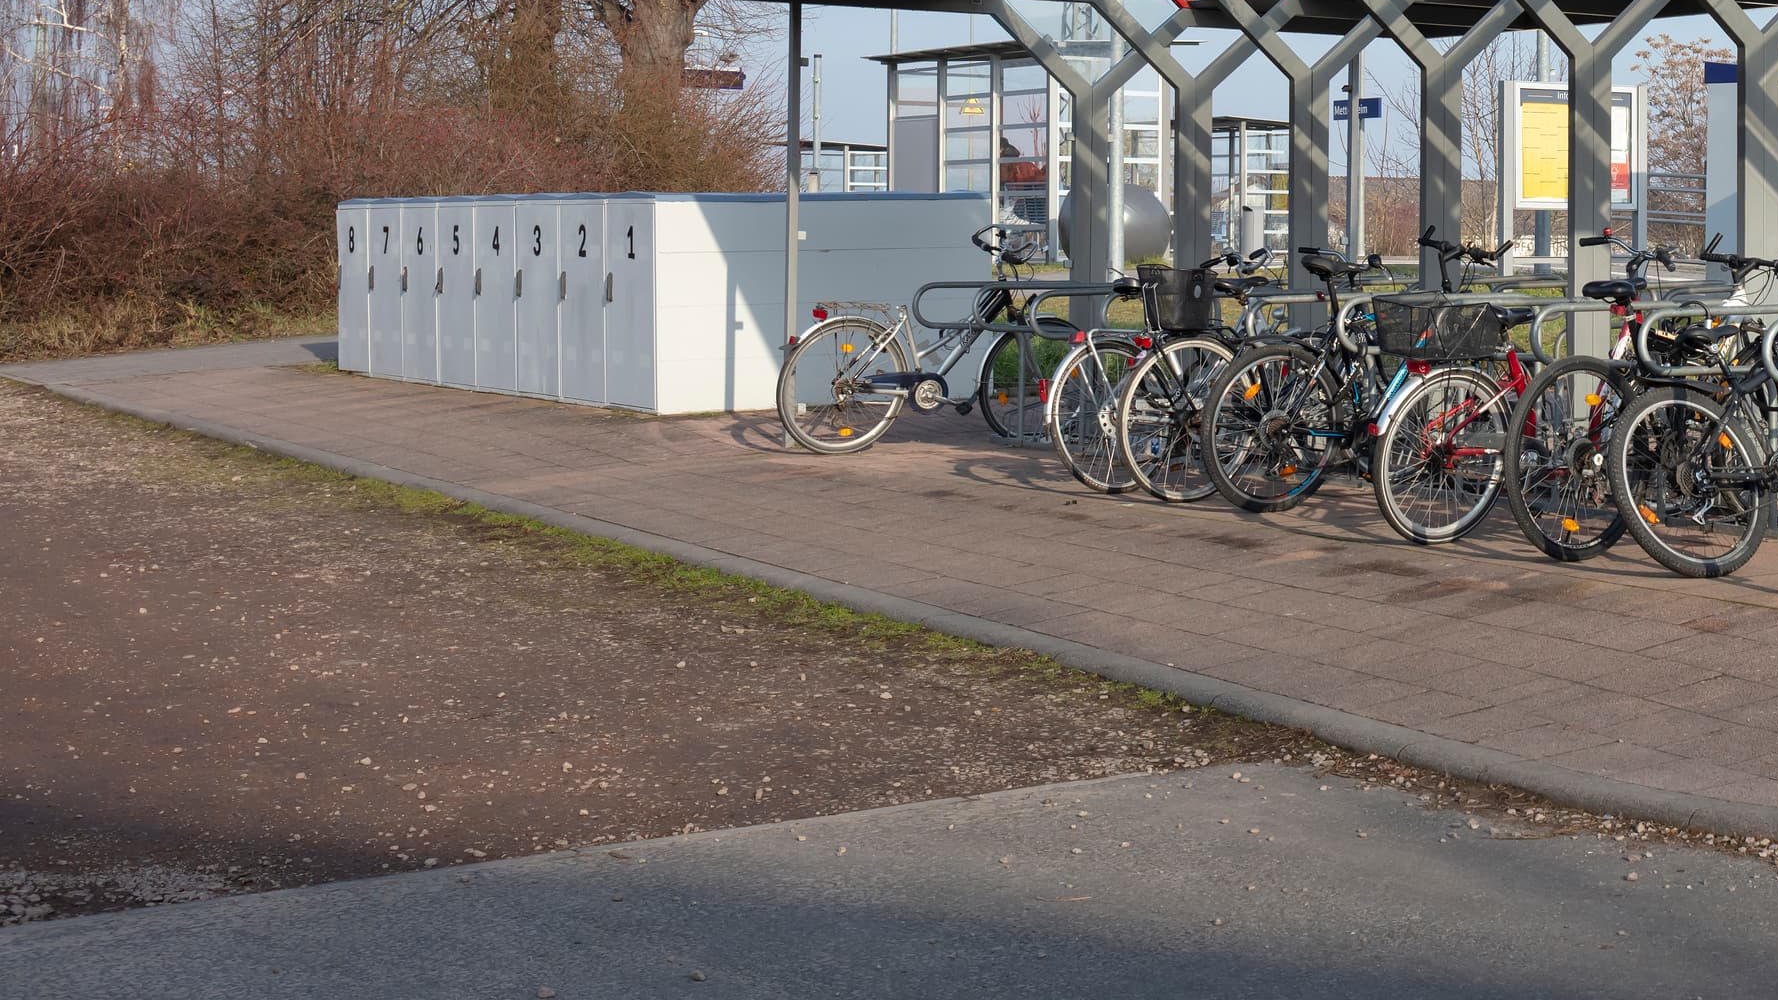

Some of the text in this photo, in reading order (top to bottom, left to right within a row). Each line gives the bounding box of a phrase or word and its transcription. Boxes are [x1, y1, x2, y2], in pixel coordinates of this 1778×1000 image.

[1335, 104, 1368, 115] Metteim
[349, 225, 355, 254] 8
[383, 226, 389, 255] 7
[416, 226, 423, 255] 6
[453, 225, 459, 255] 5
[492, 225, 500, 256] 4
[533, 224, 541, 256] 3
[578, 224, 587, 257] 2
[627, 225, 635, 259] 1
